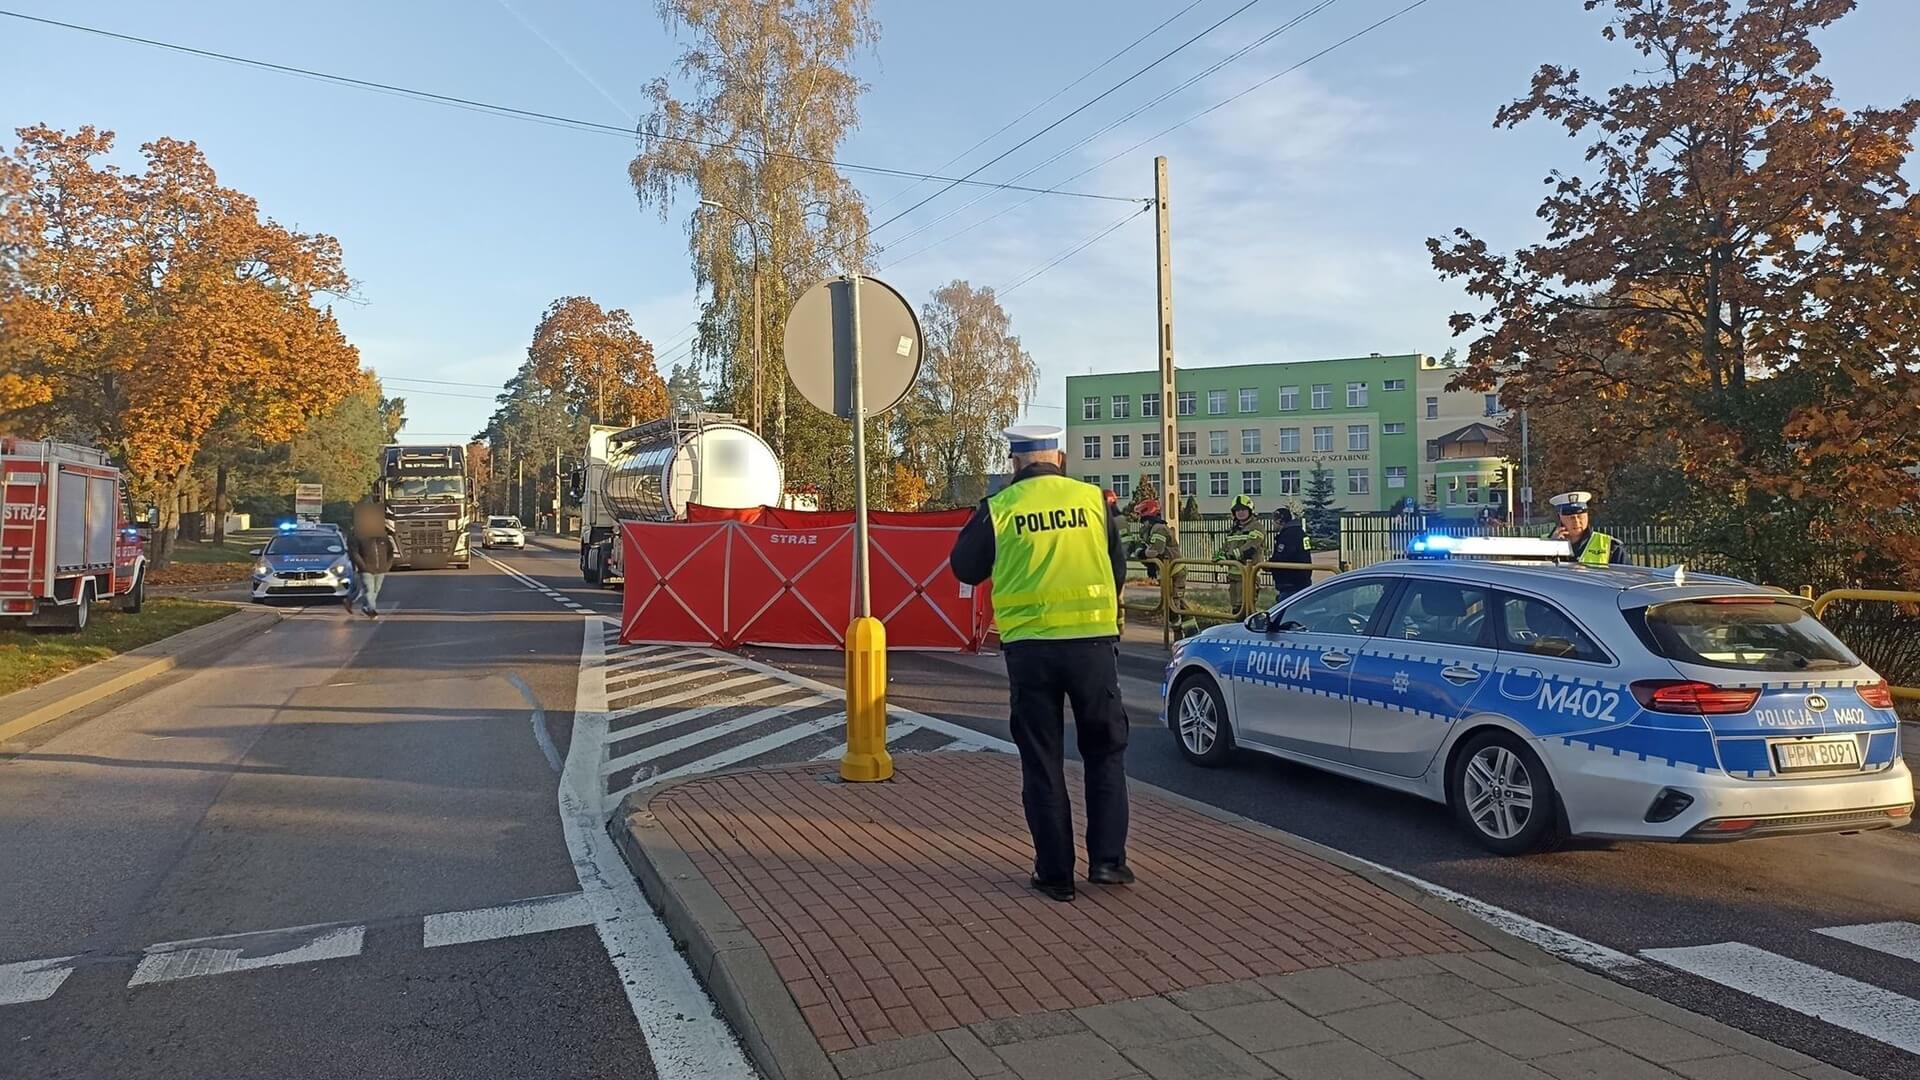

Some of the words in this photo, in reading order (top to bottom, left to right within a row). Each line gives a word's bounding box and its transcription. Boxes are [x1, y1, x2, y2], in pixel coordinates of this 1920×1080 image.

[5, 505, 46, 520] STRAŻ
[1014, 508, 1088, 535] POLICJA
[1247, 650, 1311, 681] POLICJA
[1537, 682, 1620, 723] M402
[1755, 708, 1815, 727] POLICJA
[1833, 708, 1867, 725] M402
